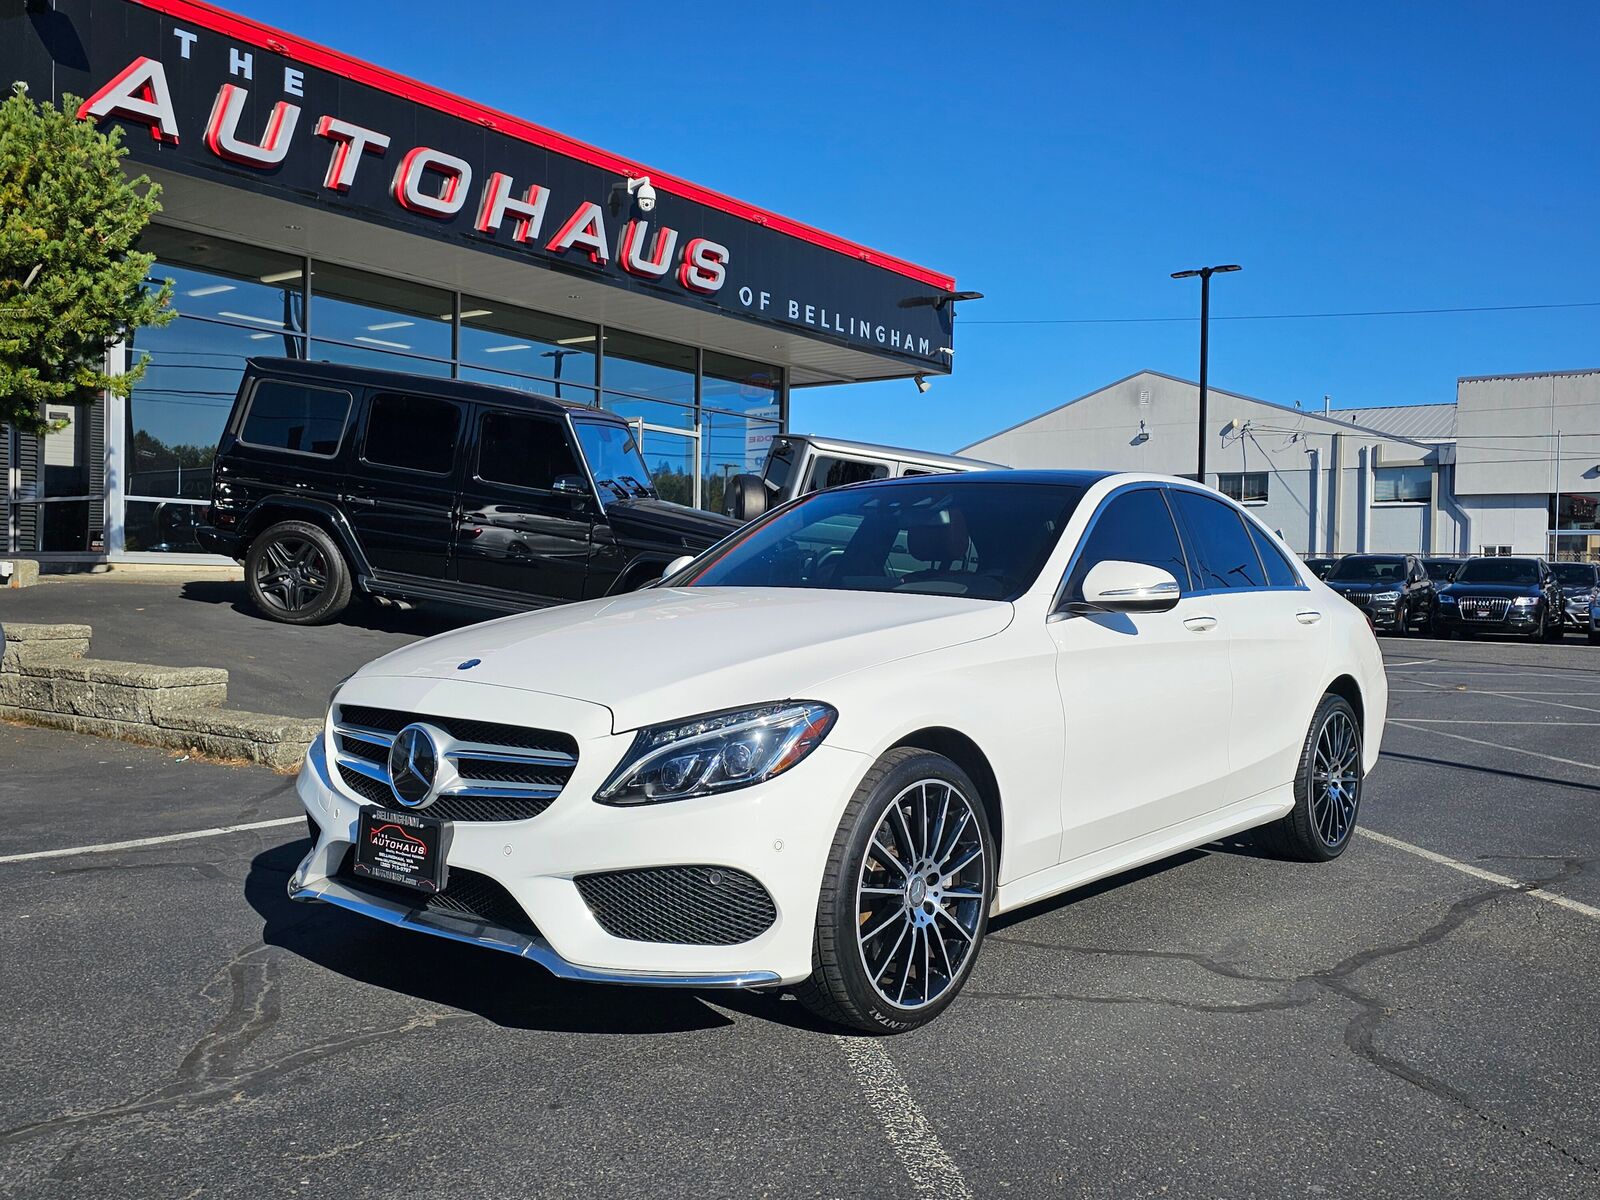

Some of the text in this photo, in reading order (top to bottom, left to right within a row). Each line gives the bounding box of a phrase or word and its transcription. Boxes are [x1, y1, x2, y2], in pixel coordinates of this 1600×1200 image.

[174, 28, 304, 98] THE
[77, 56, 730, 294] AUTOHAUS
[739, 286, 931, 356] OF BELLINGHAM
[372, 837, 425, 855] AUTOHAUS
[376, 810, 420, 828] BELLINGHAM
